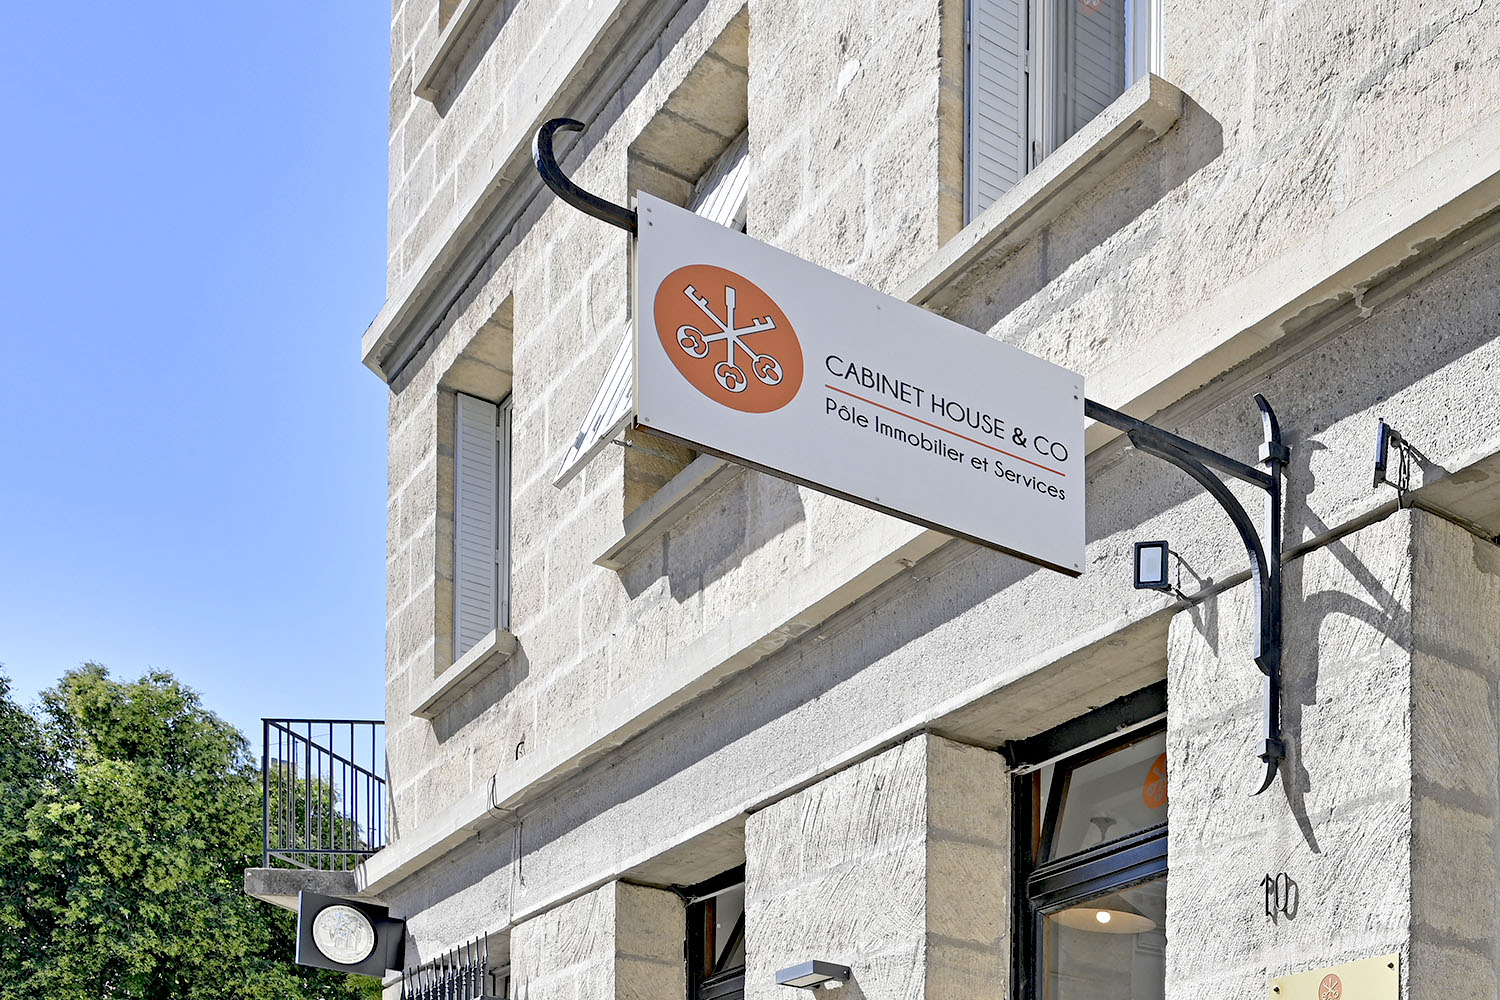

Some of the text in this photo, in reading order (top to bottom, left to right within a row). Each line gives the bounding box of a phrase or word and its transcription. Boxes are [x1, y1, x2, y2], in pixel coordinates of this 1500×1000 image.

[825, 355, 1068, 462] CABINET HOUSE & CO
[826, 397, 1066, 501] Pôle Immobilier et Services
[1259, 873, 1288, 917] 10
